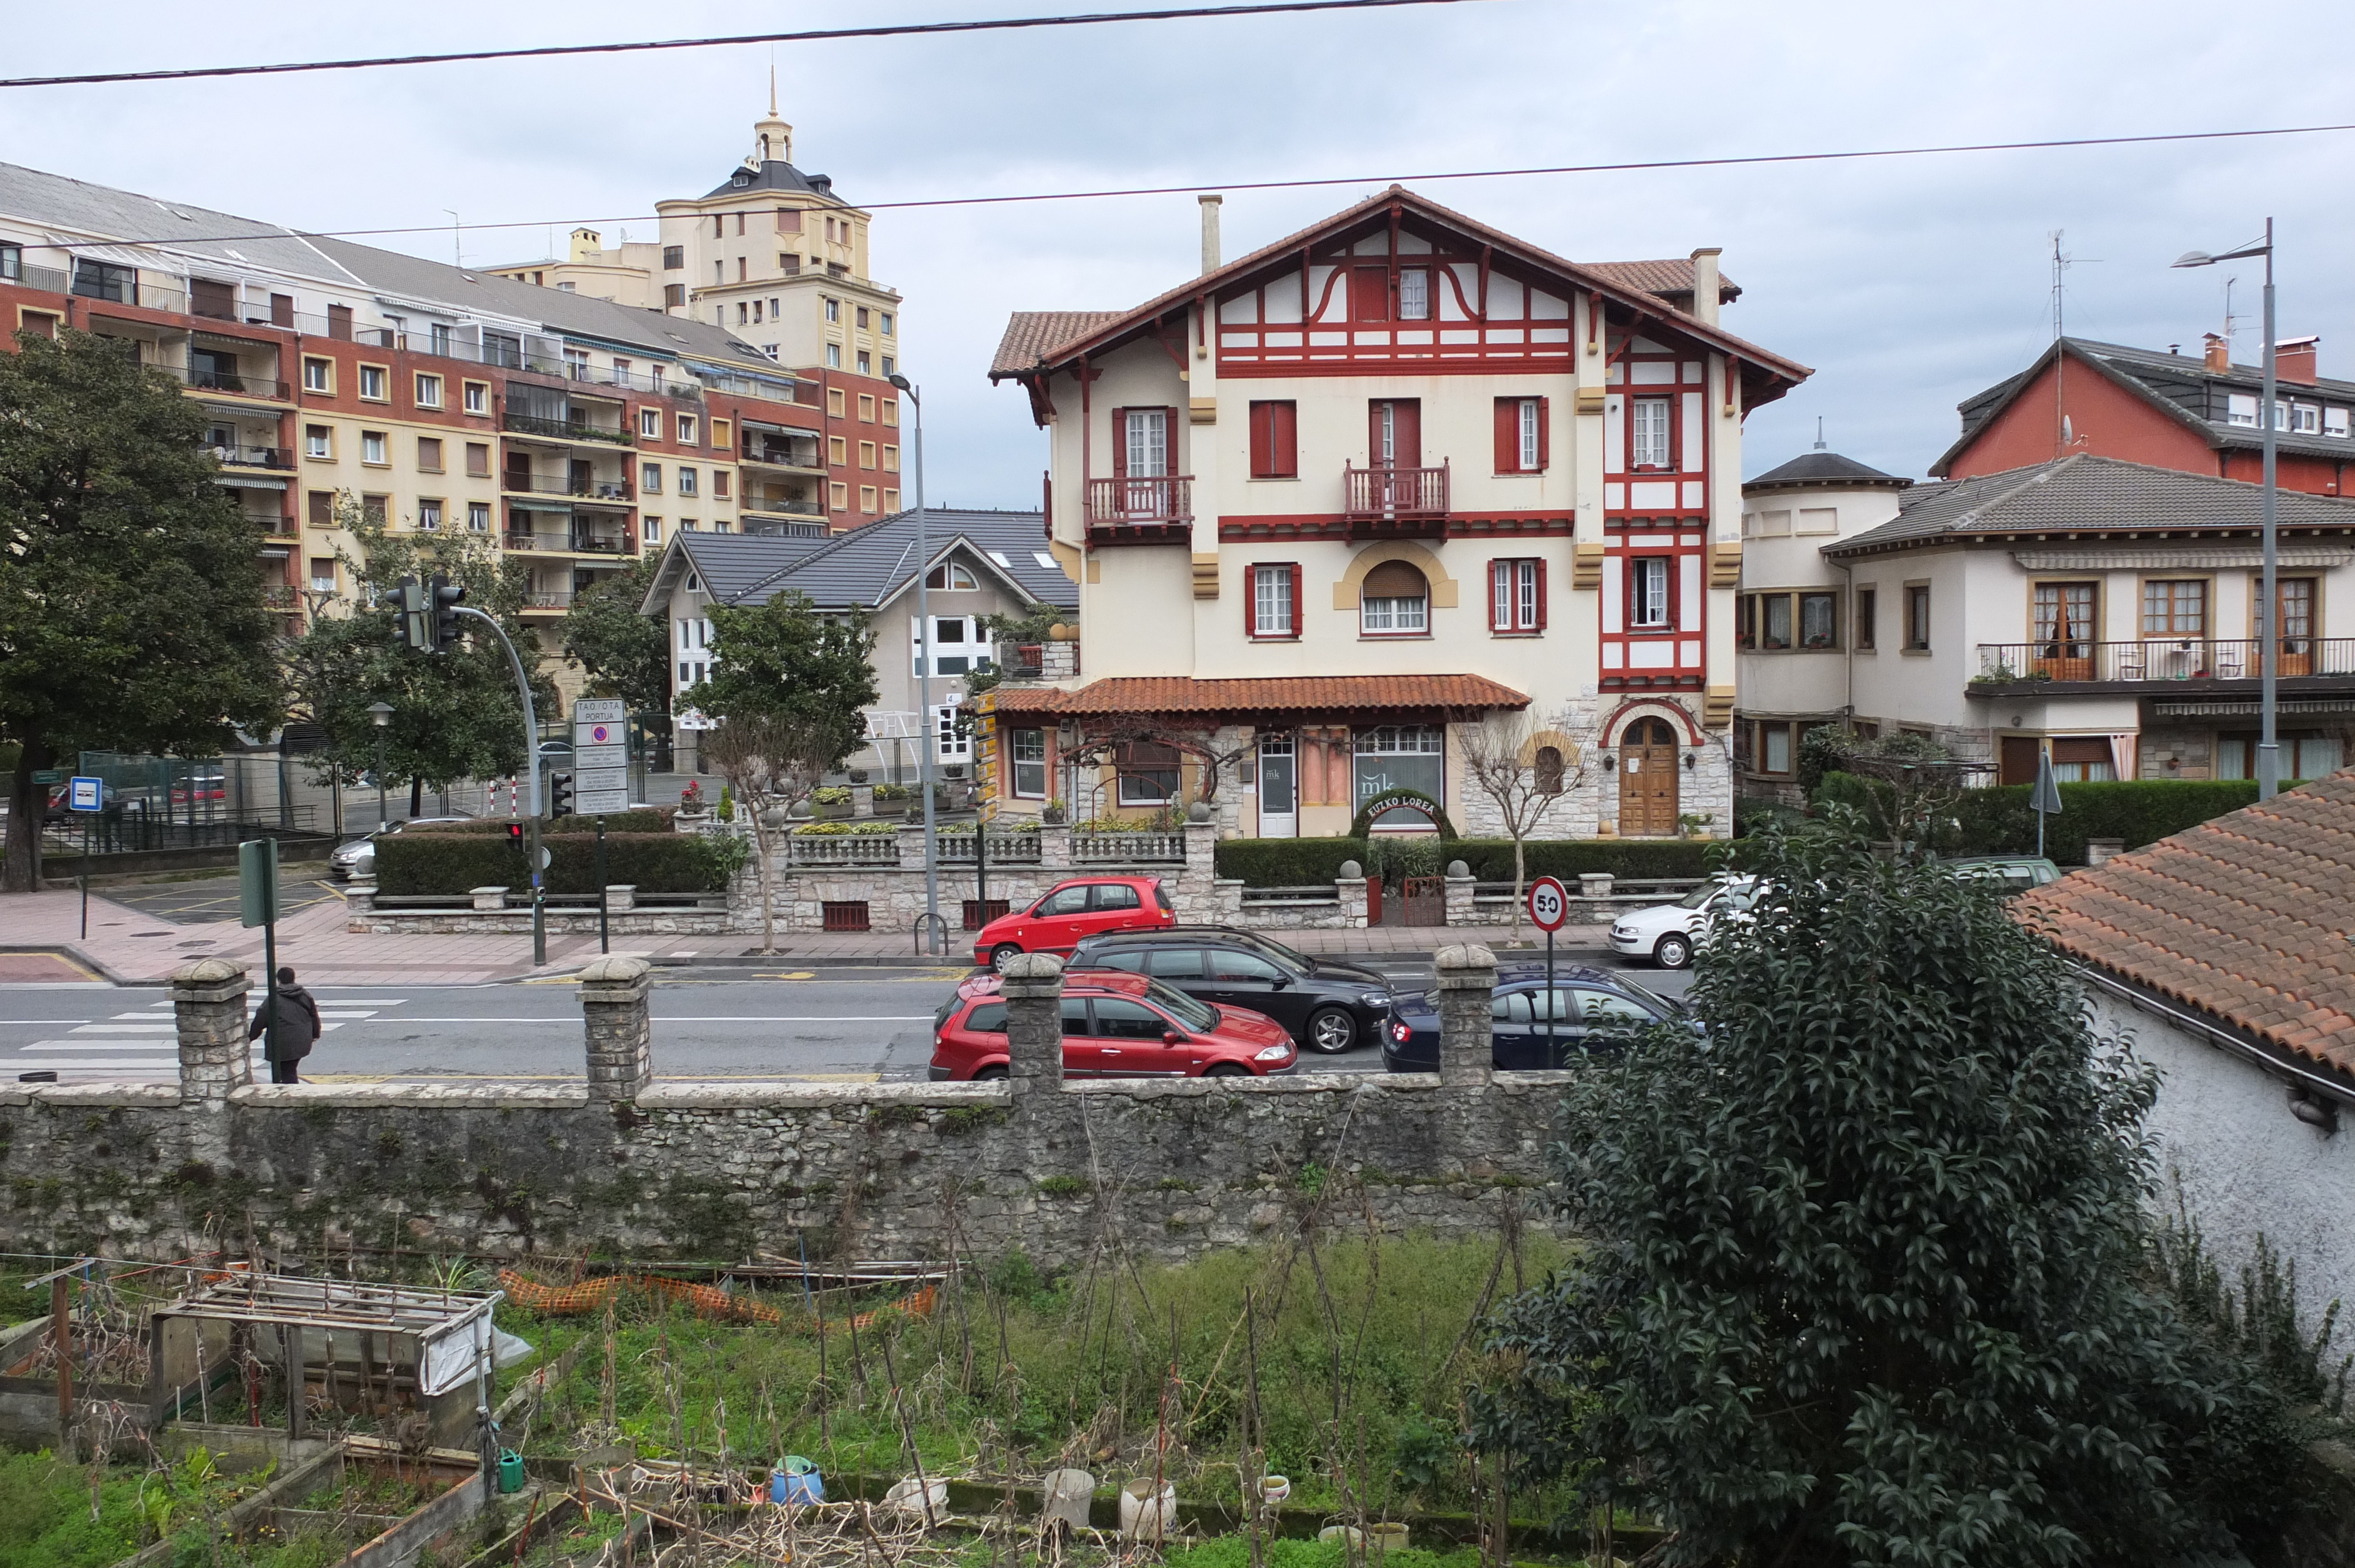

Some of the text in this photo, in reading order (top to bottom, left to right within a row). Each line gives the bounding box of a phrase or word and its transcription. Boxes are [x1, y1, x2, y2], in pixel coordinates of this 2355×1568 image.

[585, 713, 614, 721] PORTUA
[1361, 773, 1395, 795] mk
[1368, 796, 1435, 818] EUZKO LOREA
[1537, 895, 1558, 913] 50
